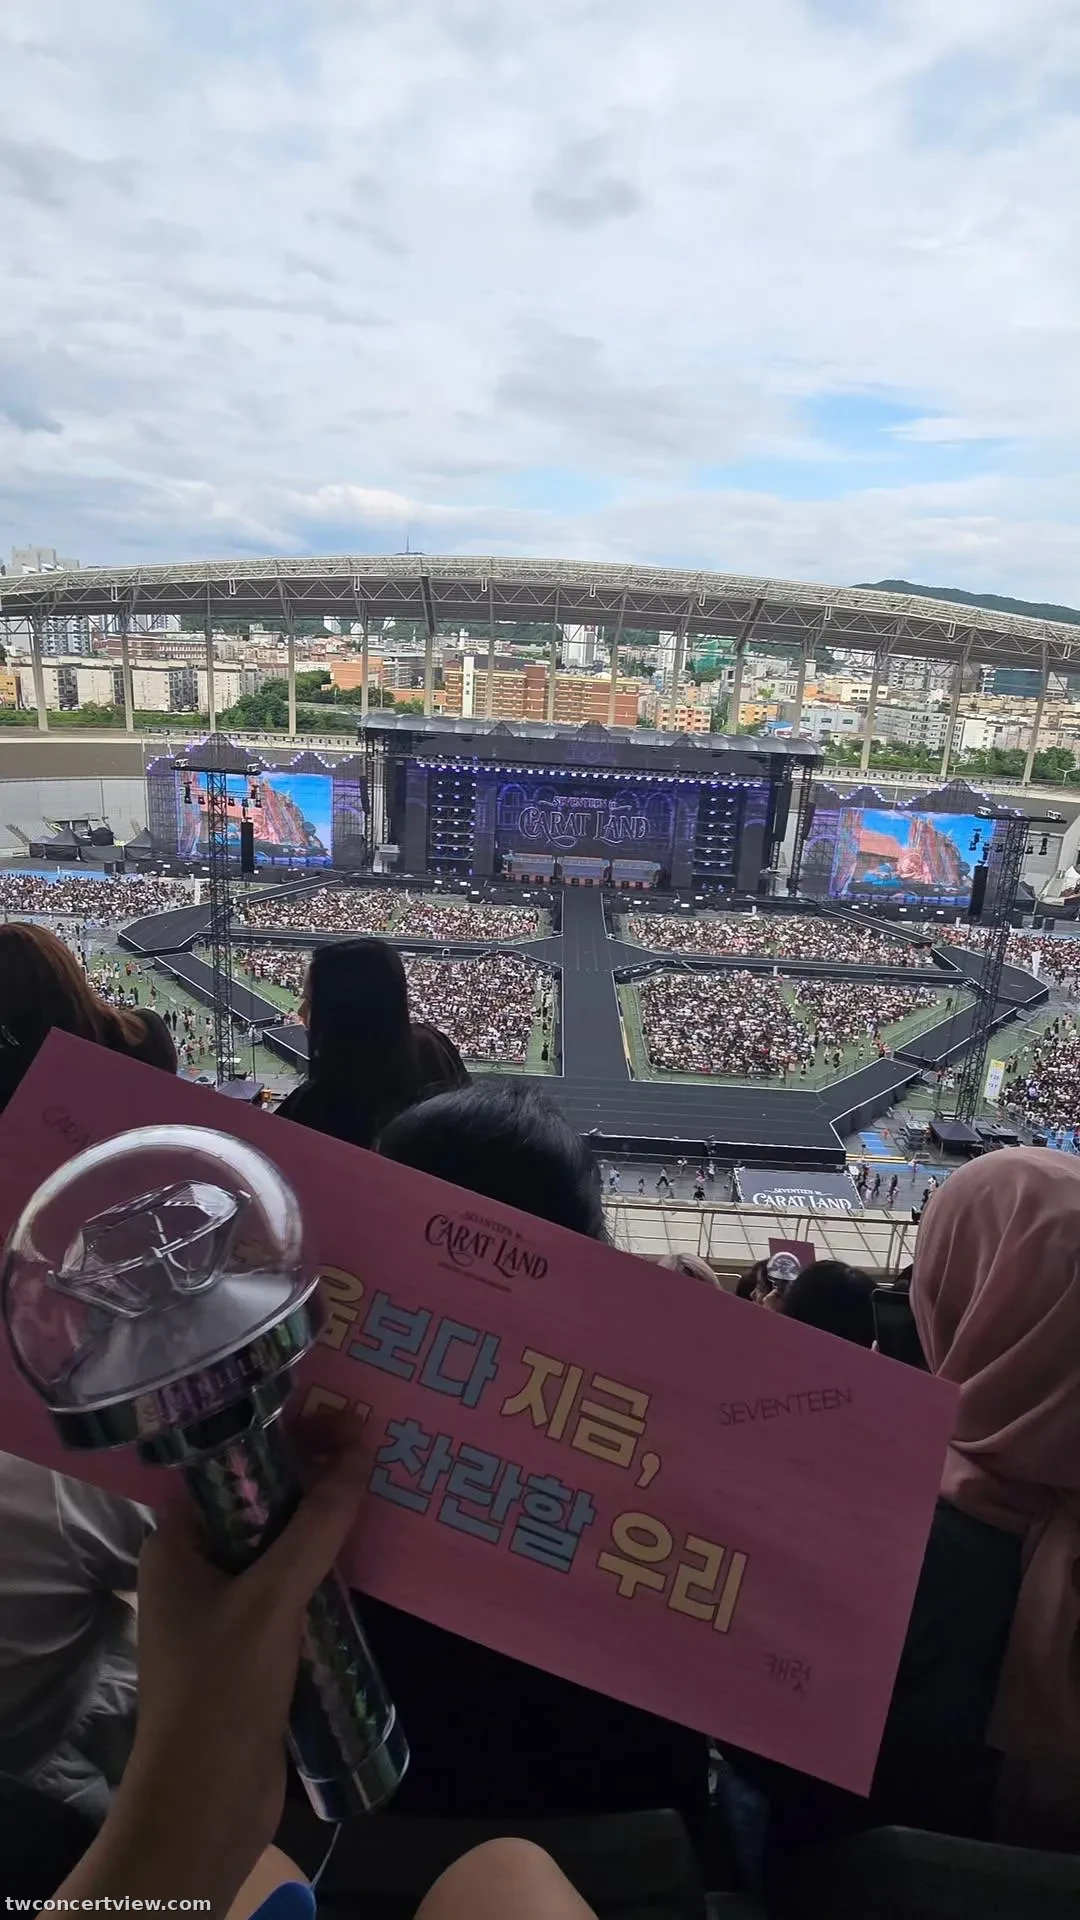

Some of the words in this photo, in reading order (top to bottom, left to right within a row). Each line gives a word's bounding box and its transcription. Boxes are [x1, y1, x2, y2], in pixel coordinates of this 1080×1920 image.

[518, 806, 592, 848] CARAT
[593, 811, 649, 846] LAND
[752, 1193, 806, 1208] CARAT
[425, 1213, 496, 1268] CARAT
[493, 1239, 549, 1281] LAND
[499, 1346, 662, 1489] 지금,
[718, 1387, 853, 1426] SEVENTEEN
[367, 1417, 599, 1574] 찬란할
[596, 1510, 750, 1635] 우리
